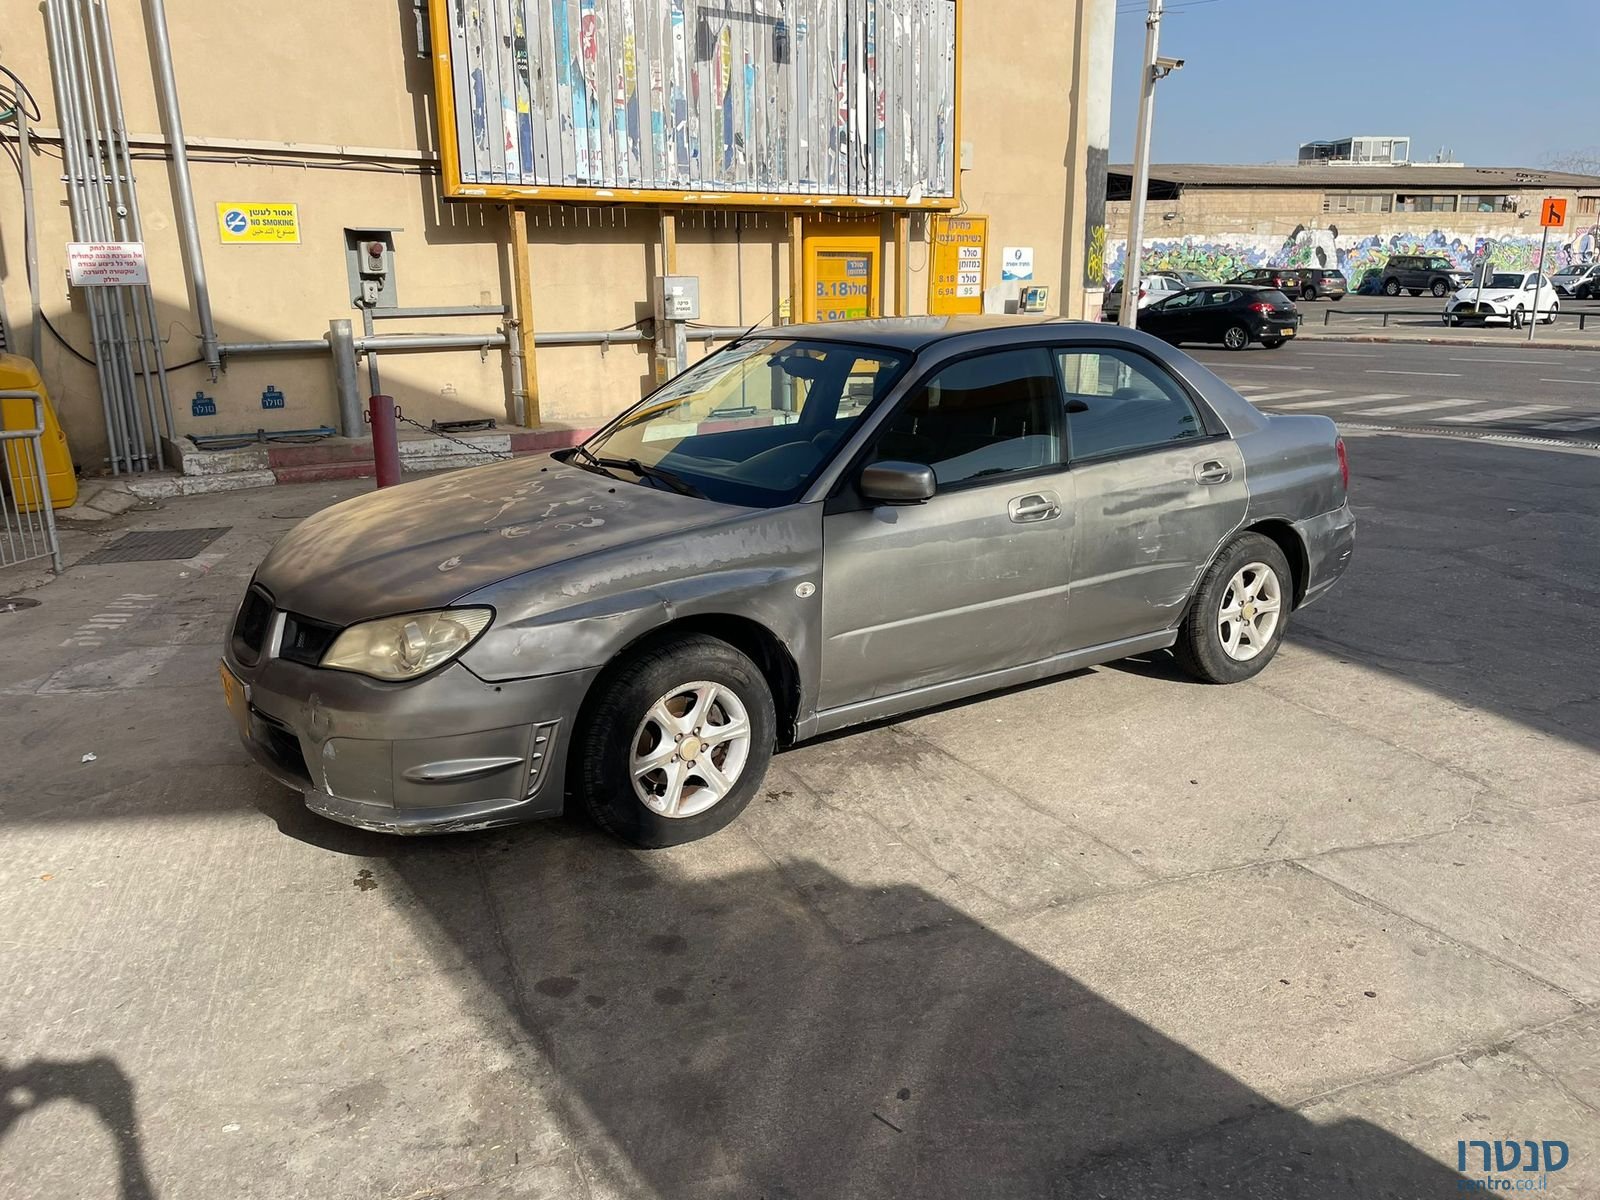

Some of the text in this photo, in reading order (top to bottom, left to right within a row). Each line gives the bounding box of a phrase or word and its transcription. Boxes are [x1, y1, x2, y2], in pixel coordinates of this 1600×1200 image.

[249, 208, 271, 217] לעשן
[262, 219, 294, 227] SMOKING
[937, 234, 982, 242] בשירות עצמי
[963, 248, 978, 257] סולר
[959, 259, 981, 270] במזומן
[938, 273, 977, 283] 8.18 סולר
[817, 281, 869, 296] 8.18 סולר
[938, 287, 974, 296] 6.94 95
[263, 398, 283, 407] סולר
[193, 404, 215, 414] סולר
